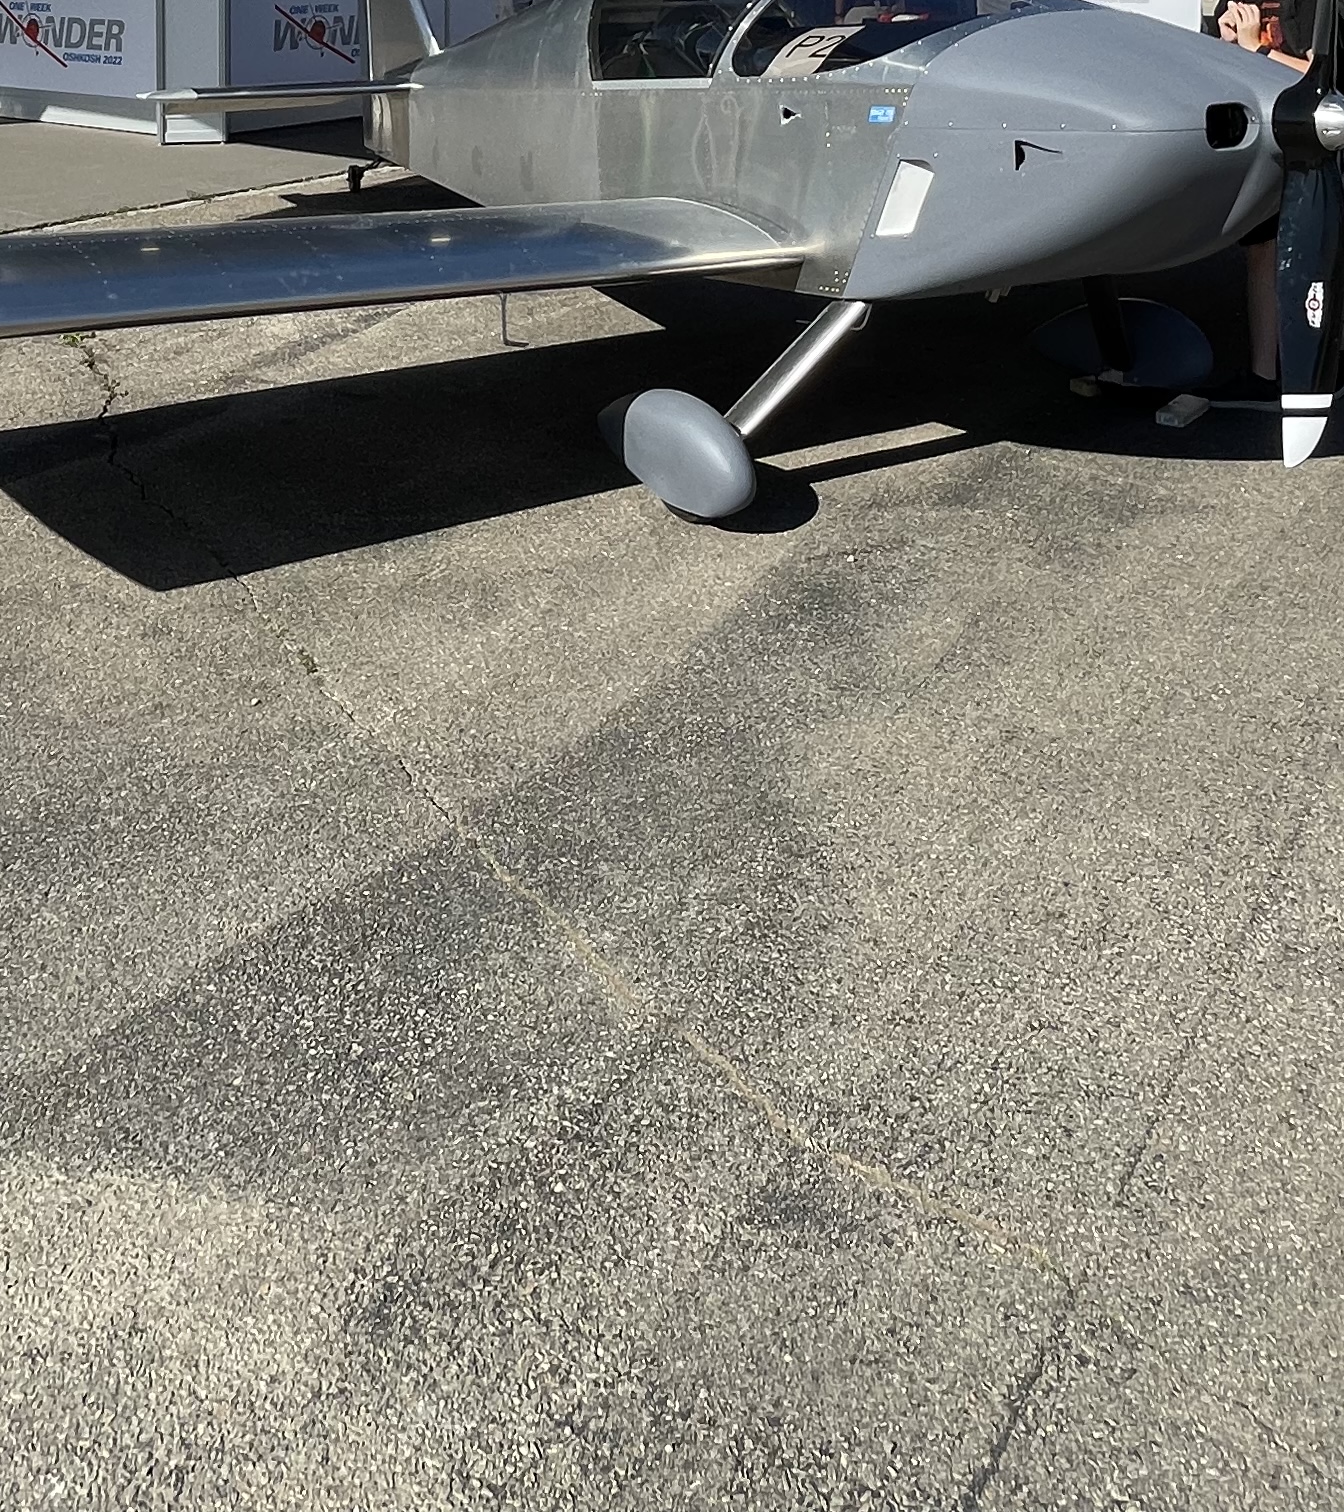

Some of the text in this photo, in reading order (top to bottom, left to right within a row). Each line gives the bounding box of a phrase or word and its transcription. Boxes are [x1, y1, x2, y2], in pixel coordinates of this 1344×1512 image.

[8, 1, 52, 13] ONE WEEK
[289, 4, 309, 15] ONE
[273, 15, 360, 52] WON
[784, 34, 847, 58] P2
[62, 52, 123, 66] OSHKOSH 2022
